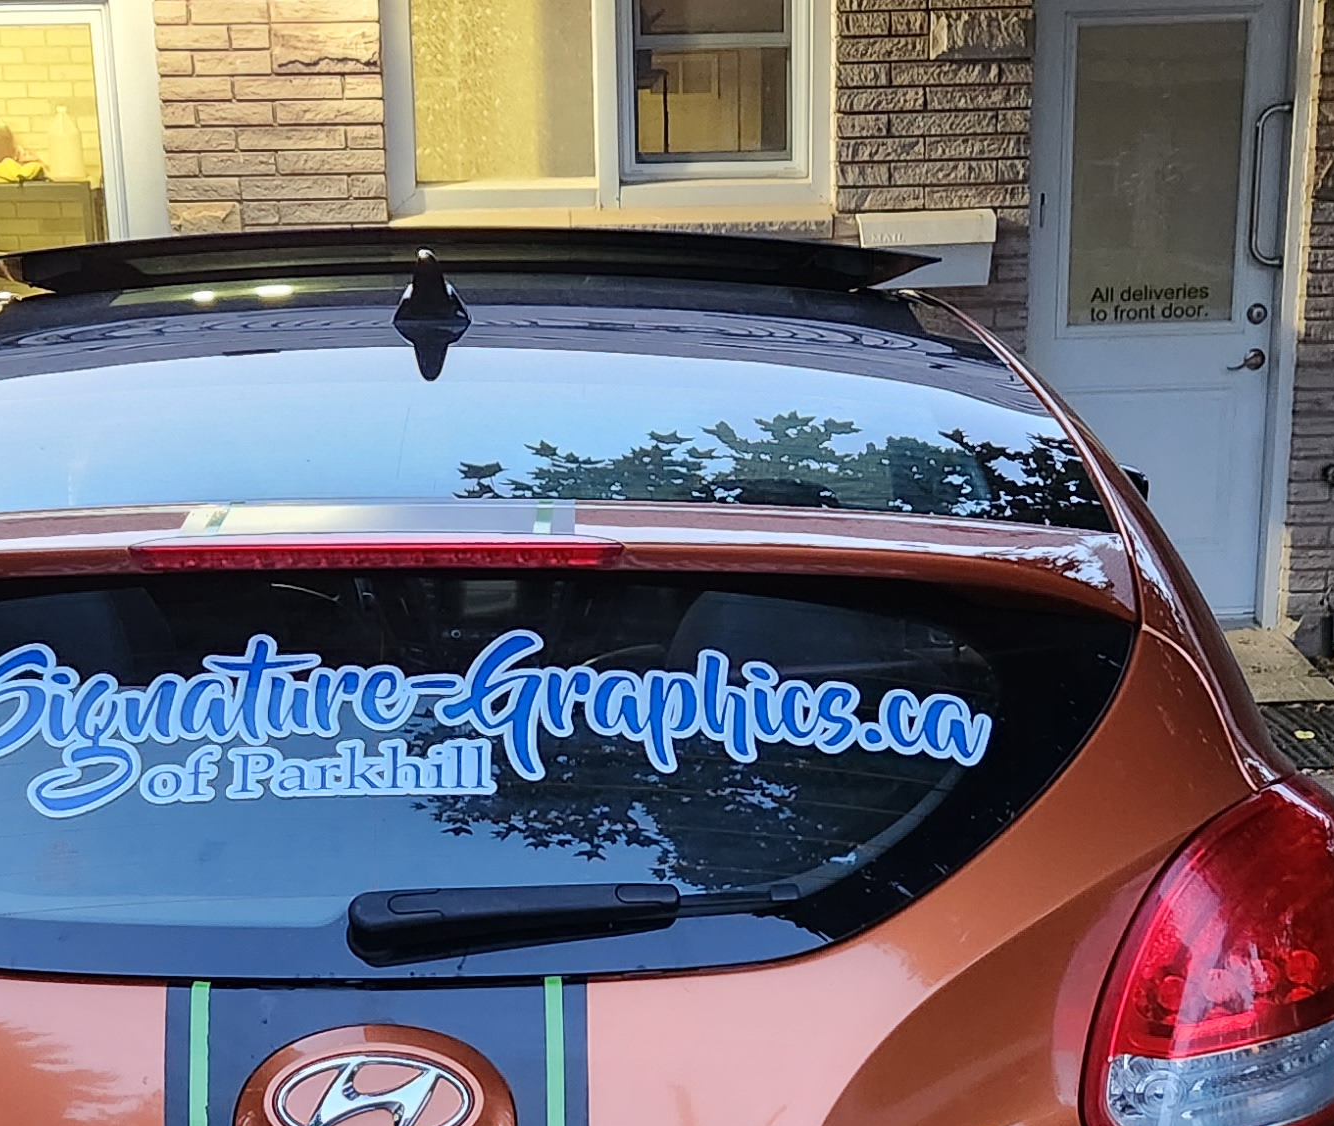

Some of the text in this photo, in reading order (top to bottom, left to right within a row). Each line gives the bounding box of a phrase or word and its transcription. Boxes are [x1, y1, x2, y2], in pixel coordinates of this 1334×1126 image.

[1090, 283, 1209, 303] All deliveries
[1090, 303, 1208, 322] to front door.
[142, 741, 495, 802] of Parkhill
